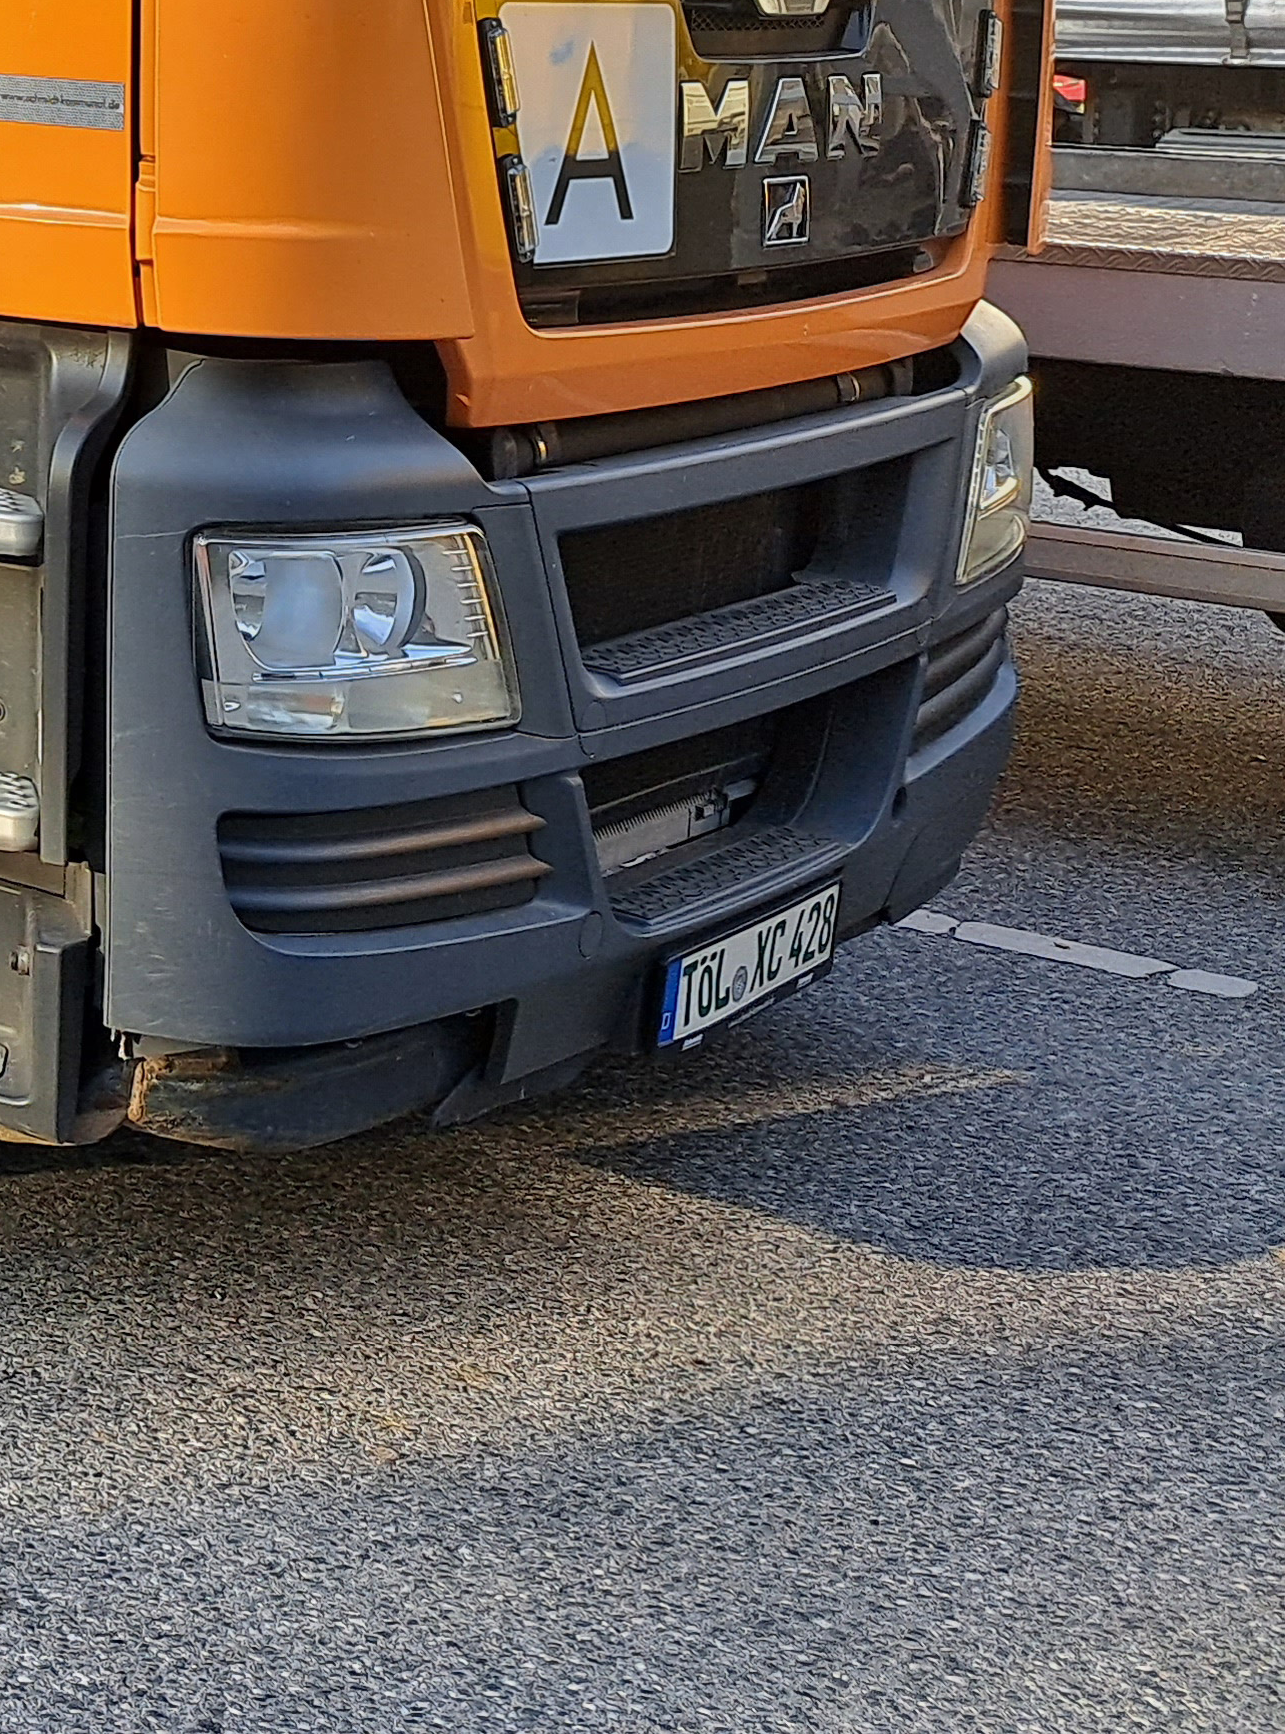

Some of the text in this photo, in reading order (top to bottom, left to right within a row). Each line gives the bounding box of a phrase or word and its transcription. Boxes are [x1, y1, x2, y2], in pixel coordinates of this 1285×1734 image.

[544, 39, 635, 225] A
[677, 71, 883, 173] MAN
[682, 948, 731, 1027] TÖL
[749, 918, 787, 994] XC
[788, 892, 836, 969] 428
[661, 1012, 673, 1030] D
